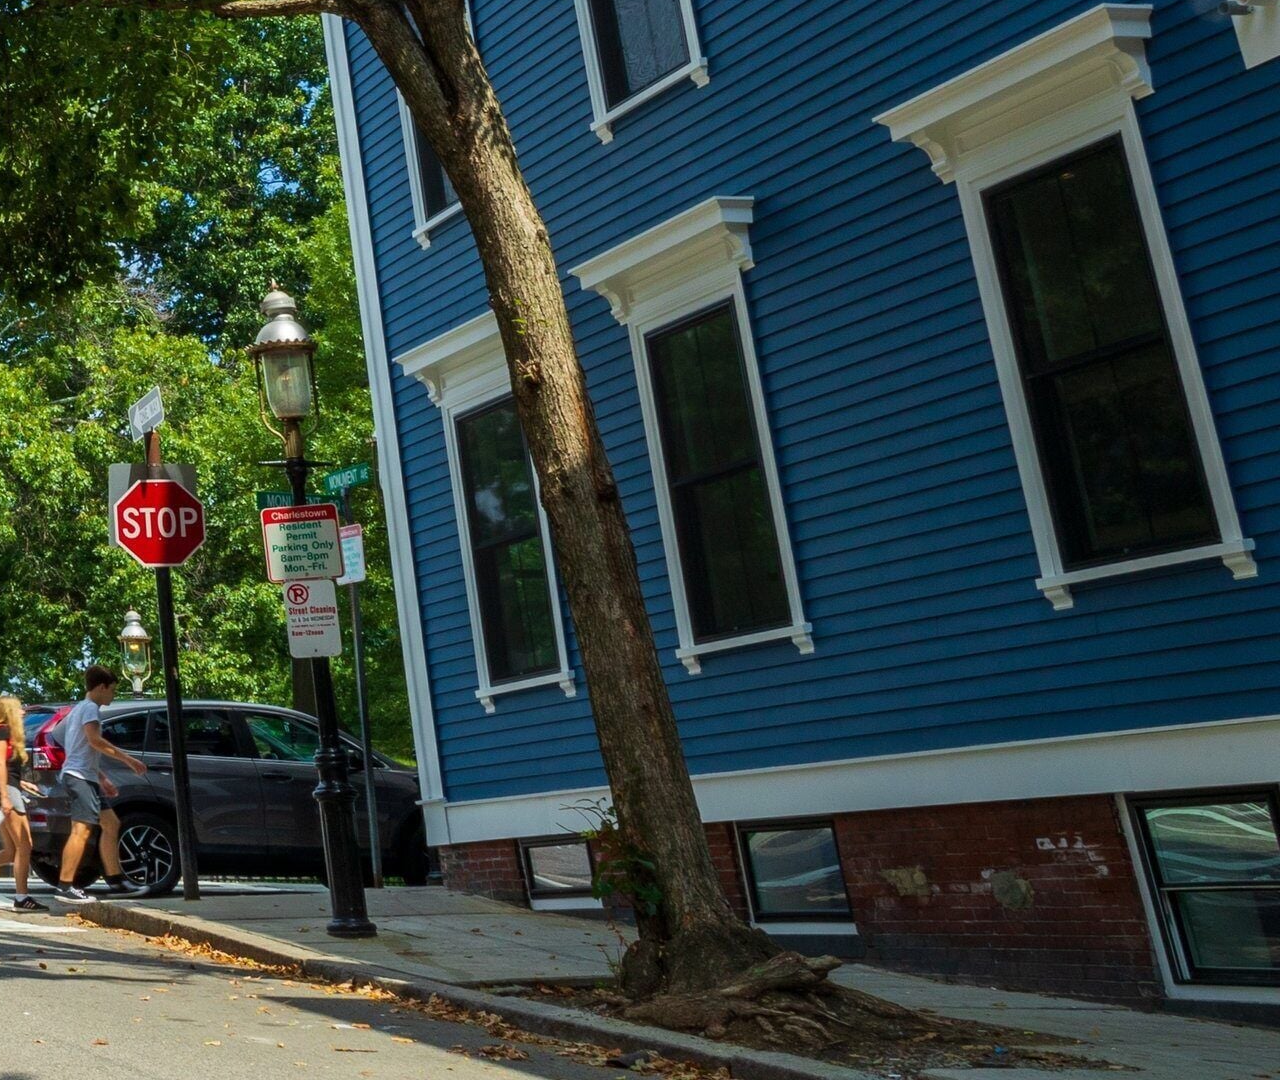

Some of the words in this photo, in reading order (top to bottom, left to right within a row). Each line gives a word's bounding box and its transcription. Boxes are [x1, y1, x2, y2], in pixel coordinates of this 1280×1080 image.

[271, 510, 328, 520] Charlestown
[122, 507, 198, 539] STOP
[279, 521, 322, 531] Resident
[286, 532, 317, 541] Permit
[272, 543, 308, 553] Parking
[312, 541, 334, 551] Only
[280, 552, 329, 562] 8am-8pm
[284, 563, 328, 573] Mon.-Fri.
[288, 606, 308, 615] Street
[310, 605, 336, 614] Cleaning
